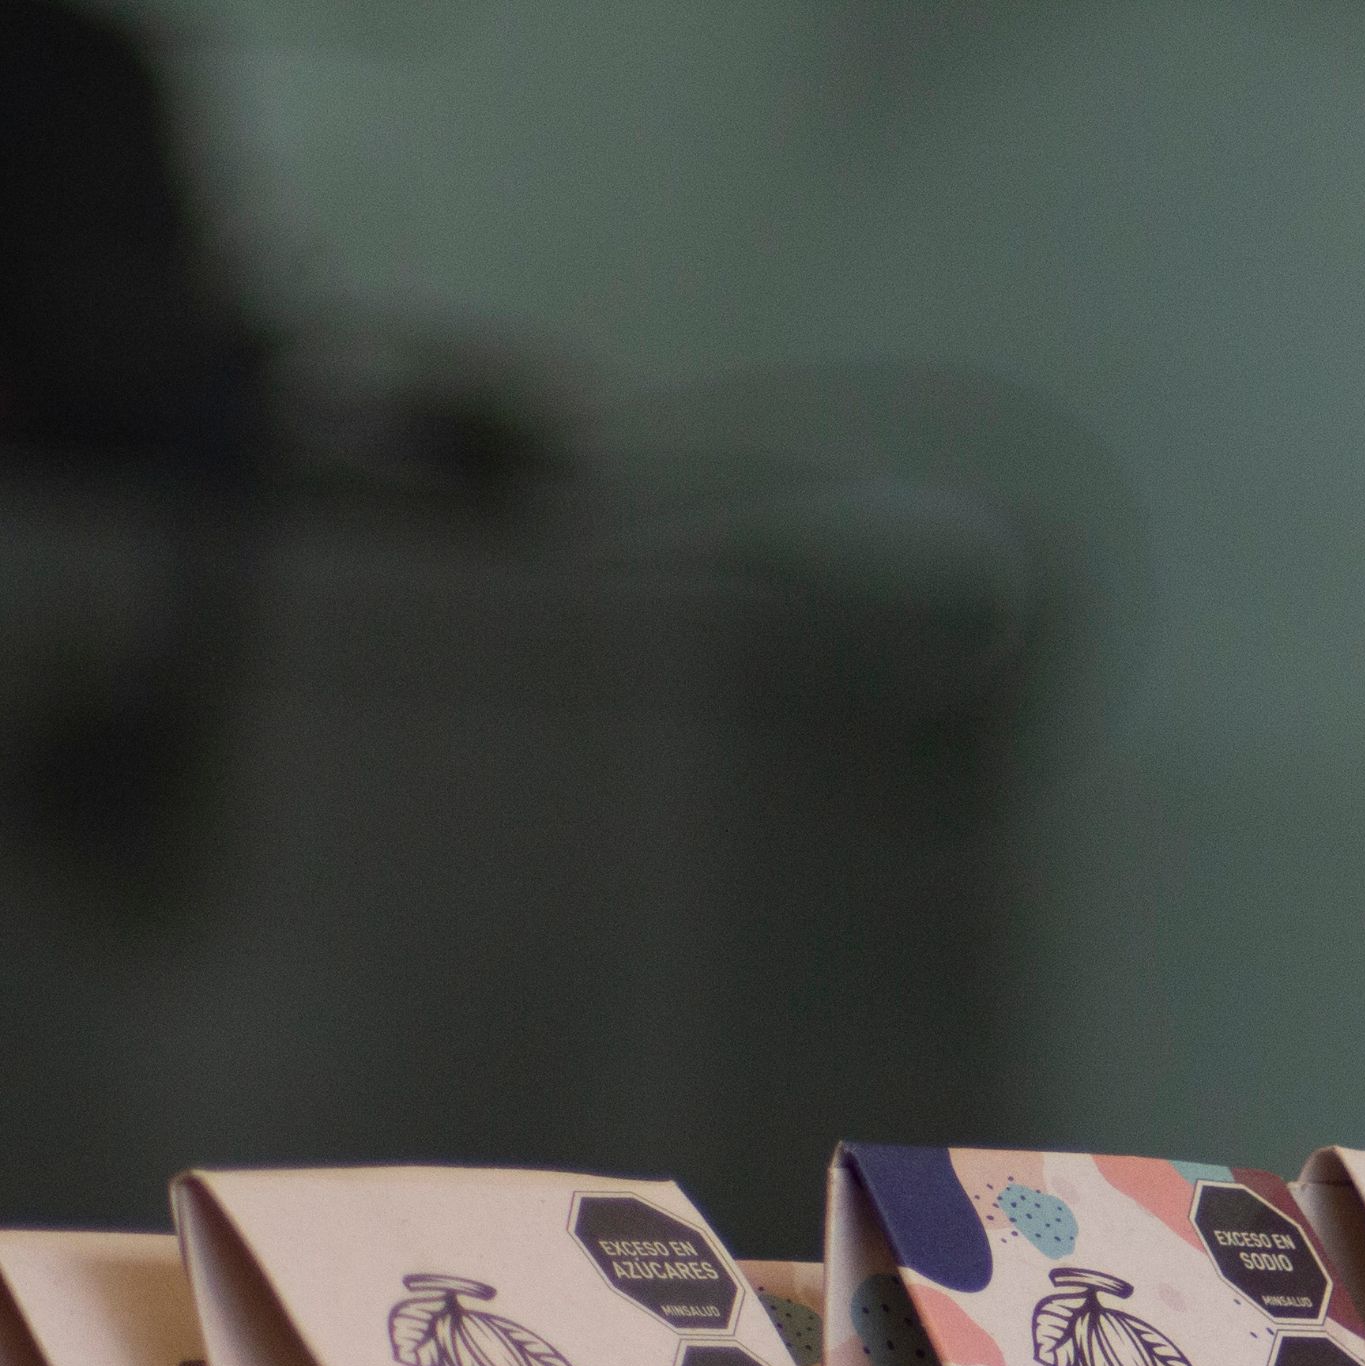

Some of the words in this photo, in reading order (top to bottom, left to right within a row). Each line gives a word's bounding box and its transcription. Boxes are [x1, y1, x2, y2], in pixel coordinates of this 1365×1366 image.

[600, 1240, 668, 1258] EXCESO
[673, 1241, 697, 1257] EN
[1215, 1230, 1270, 1249] EXCESO
[1272, 1233, 1295, 1250] EN
[614, 1257, 720, 1281] AZÚCARES
[1240, 1252, 1294, 1272] SODIO
[661, 1303, 721, 1319] MINSALUD
